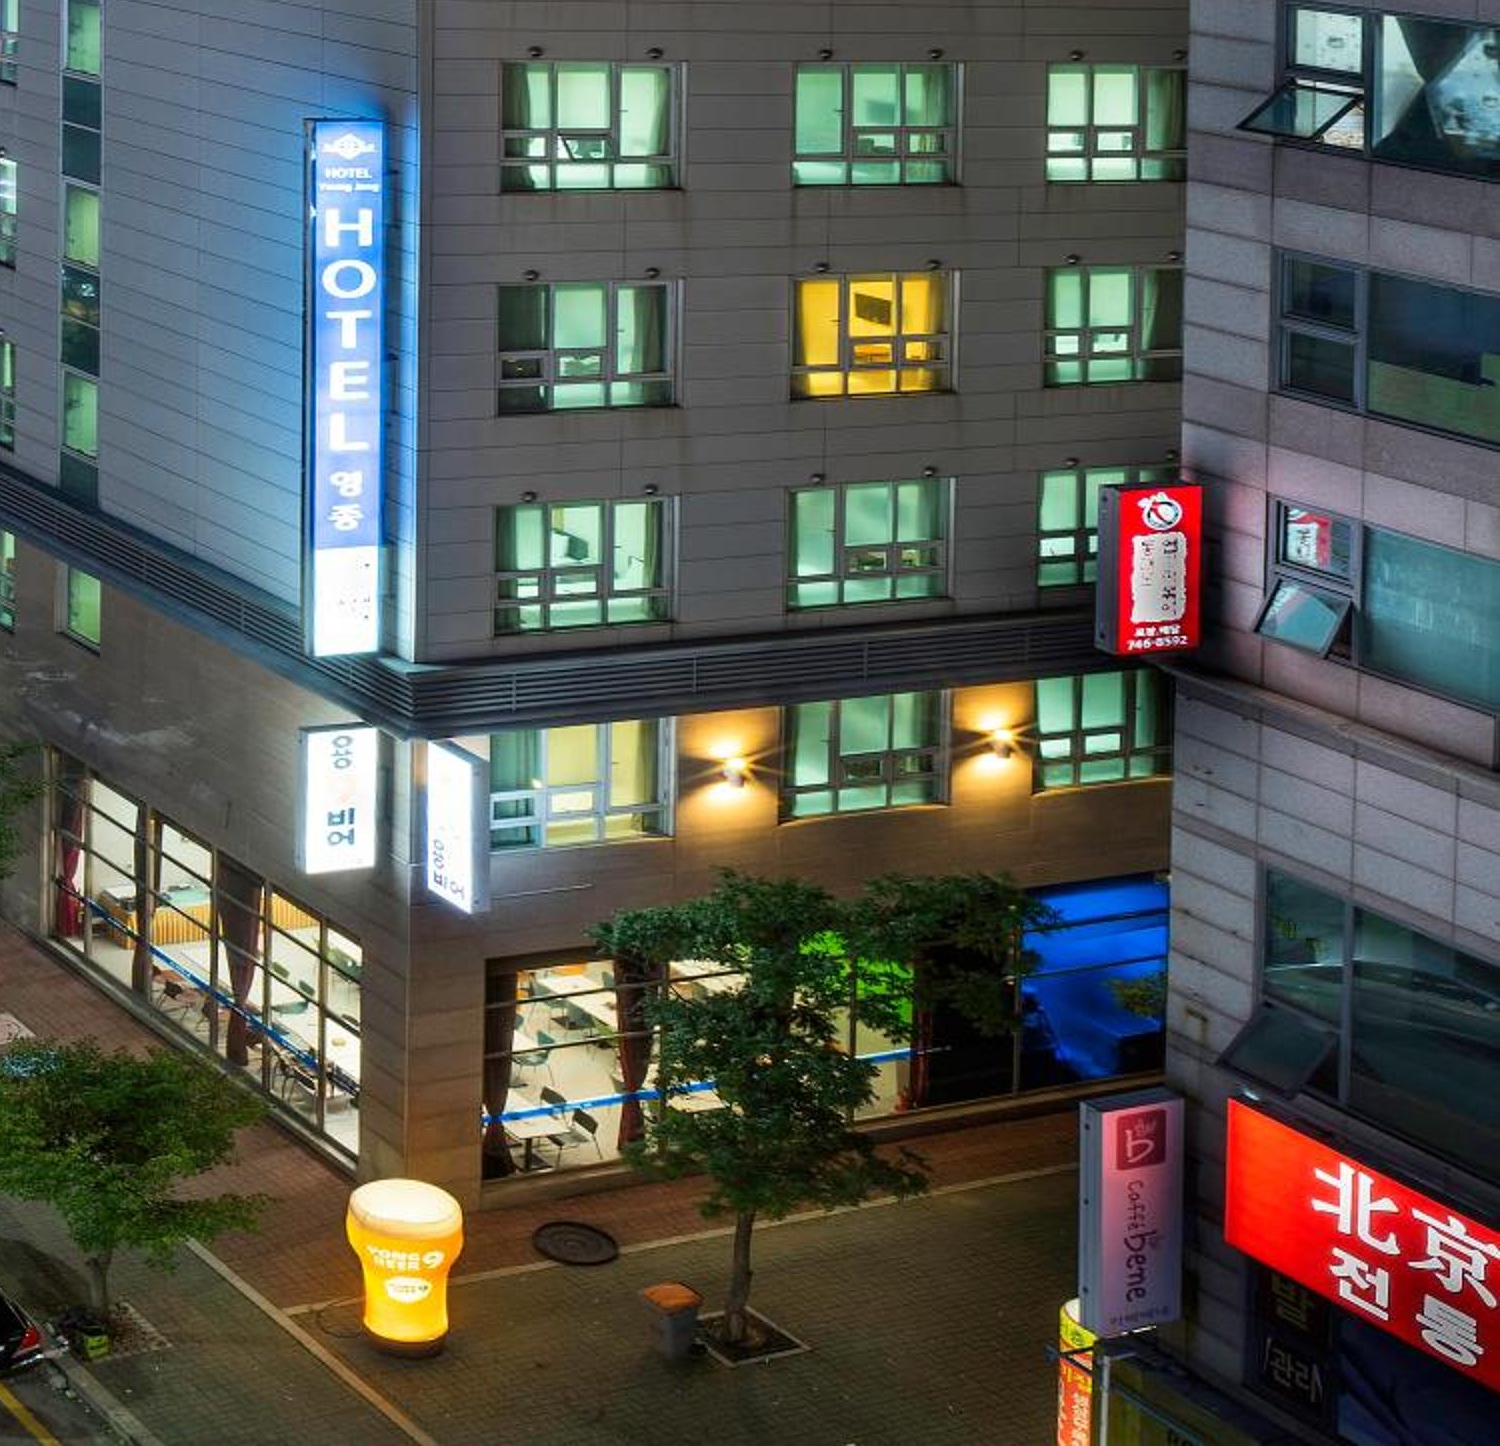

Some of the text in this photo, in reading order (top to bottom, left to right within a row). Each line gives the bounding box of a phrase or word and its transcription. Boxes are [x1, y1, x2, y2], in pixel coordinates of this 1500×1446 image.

[325, 167, 372, 179] HOTEL
[322, 207, 377, 453] HOTEL
[328, 470, 364, 533] 영종
[1311, 1161, 1500, 1309] 北京
[1329, 1246, 1484, 1367] 전통
